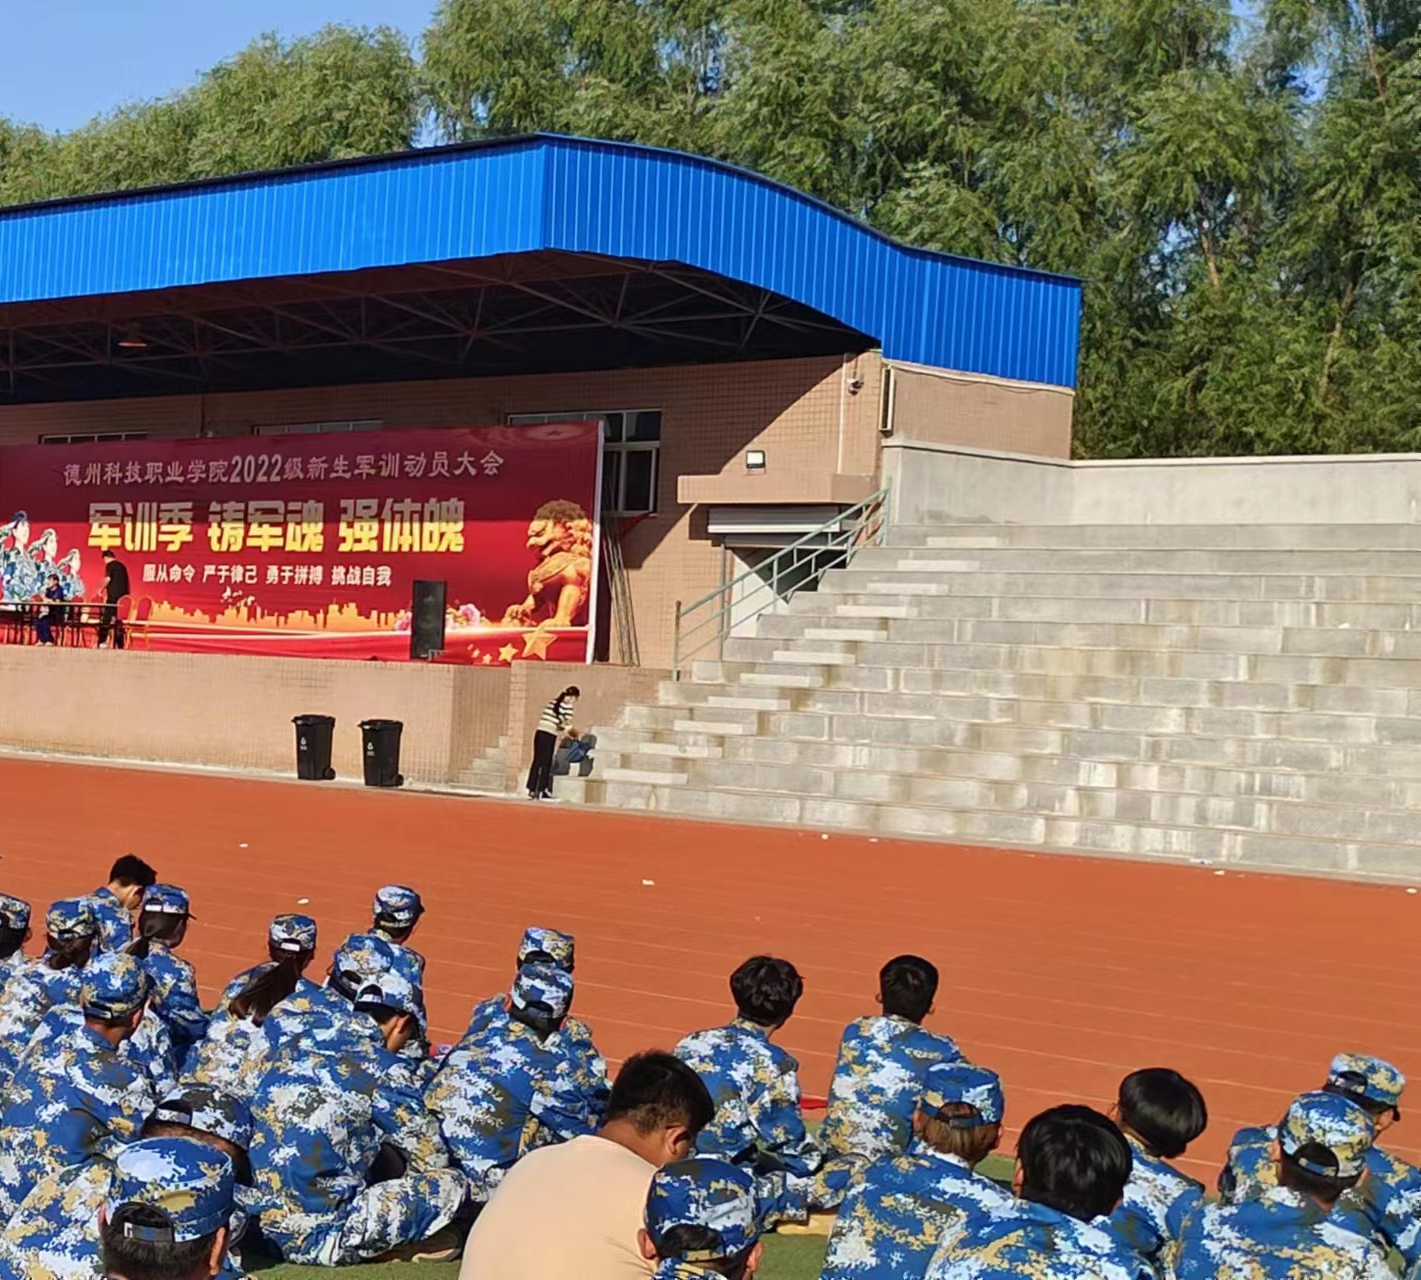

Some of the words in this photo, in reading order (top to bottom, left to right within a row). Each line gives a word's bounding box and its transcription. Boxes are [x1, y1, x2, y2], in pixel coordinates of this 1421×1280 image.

[64, 450, 504, 487] 德州科技职业学院2022级新生军训动员大会
[88, 501, 194, 552] 军训季
[208, 499, 325, 552] 铸军魂
[338, 498, 466, 553] 强体魄
[142, 563, 196, 584] 服从命令
[202, 564, 258, 585] 严于律己
[265, 564, 324, 586] 勇于拼搏
[331, 565, 392, 587] 挑战自我
